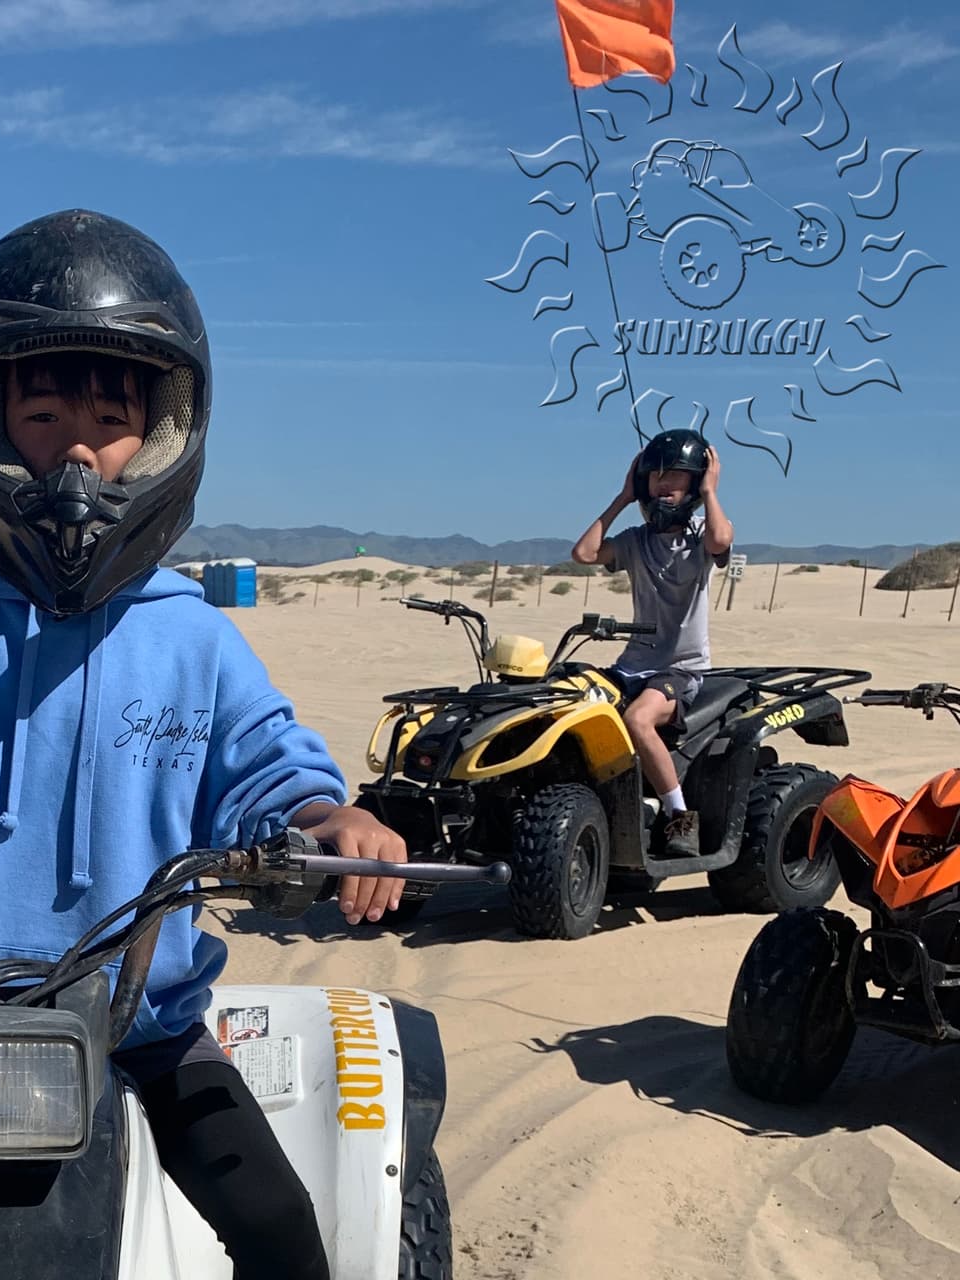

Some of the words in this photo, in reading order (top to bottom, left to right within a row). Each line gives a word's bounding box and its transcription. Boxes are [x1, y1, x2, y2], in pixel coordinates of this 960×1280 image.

[730, 566, 743, 576] 15
[175, 709, 209, 756] Isla
[132, 754, 194, 772] TEXAS
[325, 988, 386, 1130] BUTTERCUP
